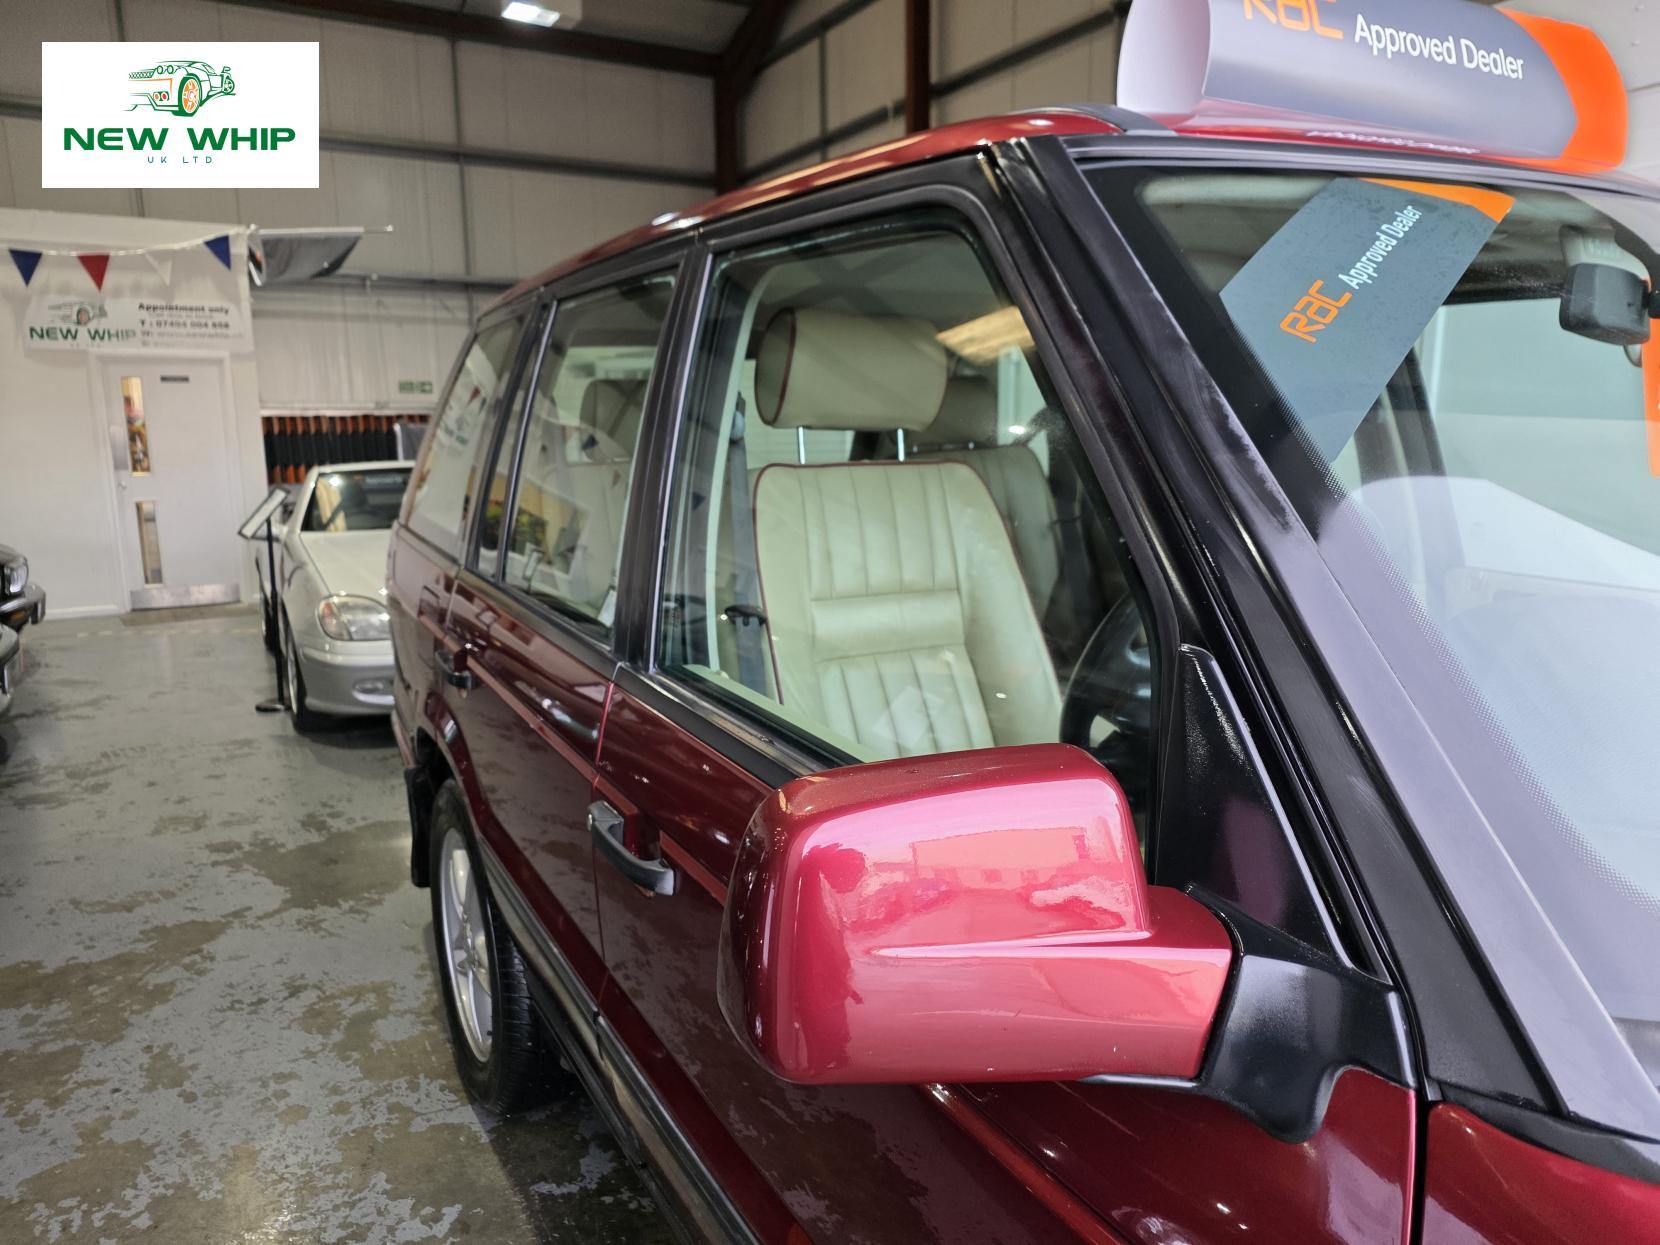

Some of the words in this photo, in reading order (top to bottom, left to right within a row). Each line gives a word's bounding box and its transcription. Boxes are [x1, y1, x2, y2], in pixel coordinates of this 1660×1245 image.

[1354, 13, 1457, 66] Approved
[1460, 37, 1525, 80] Dealer
[1337, 230, 1398, 290] Approved
[1380, 205, 1423, 239] Dealer
[29, 326, 79, 341] NEW
[87, 327, 136, 342] WHIP
